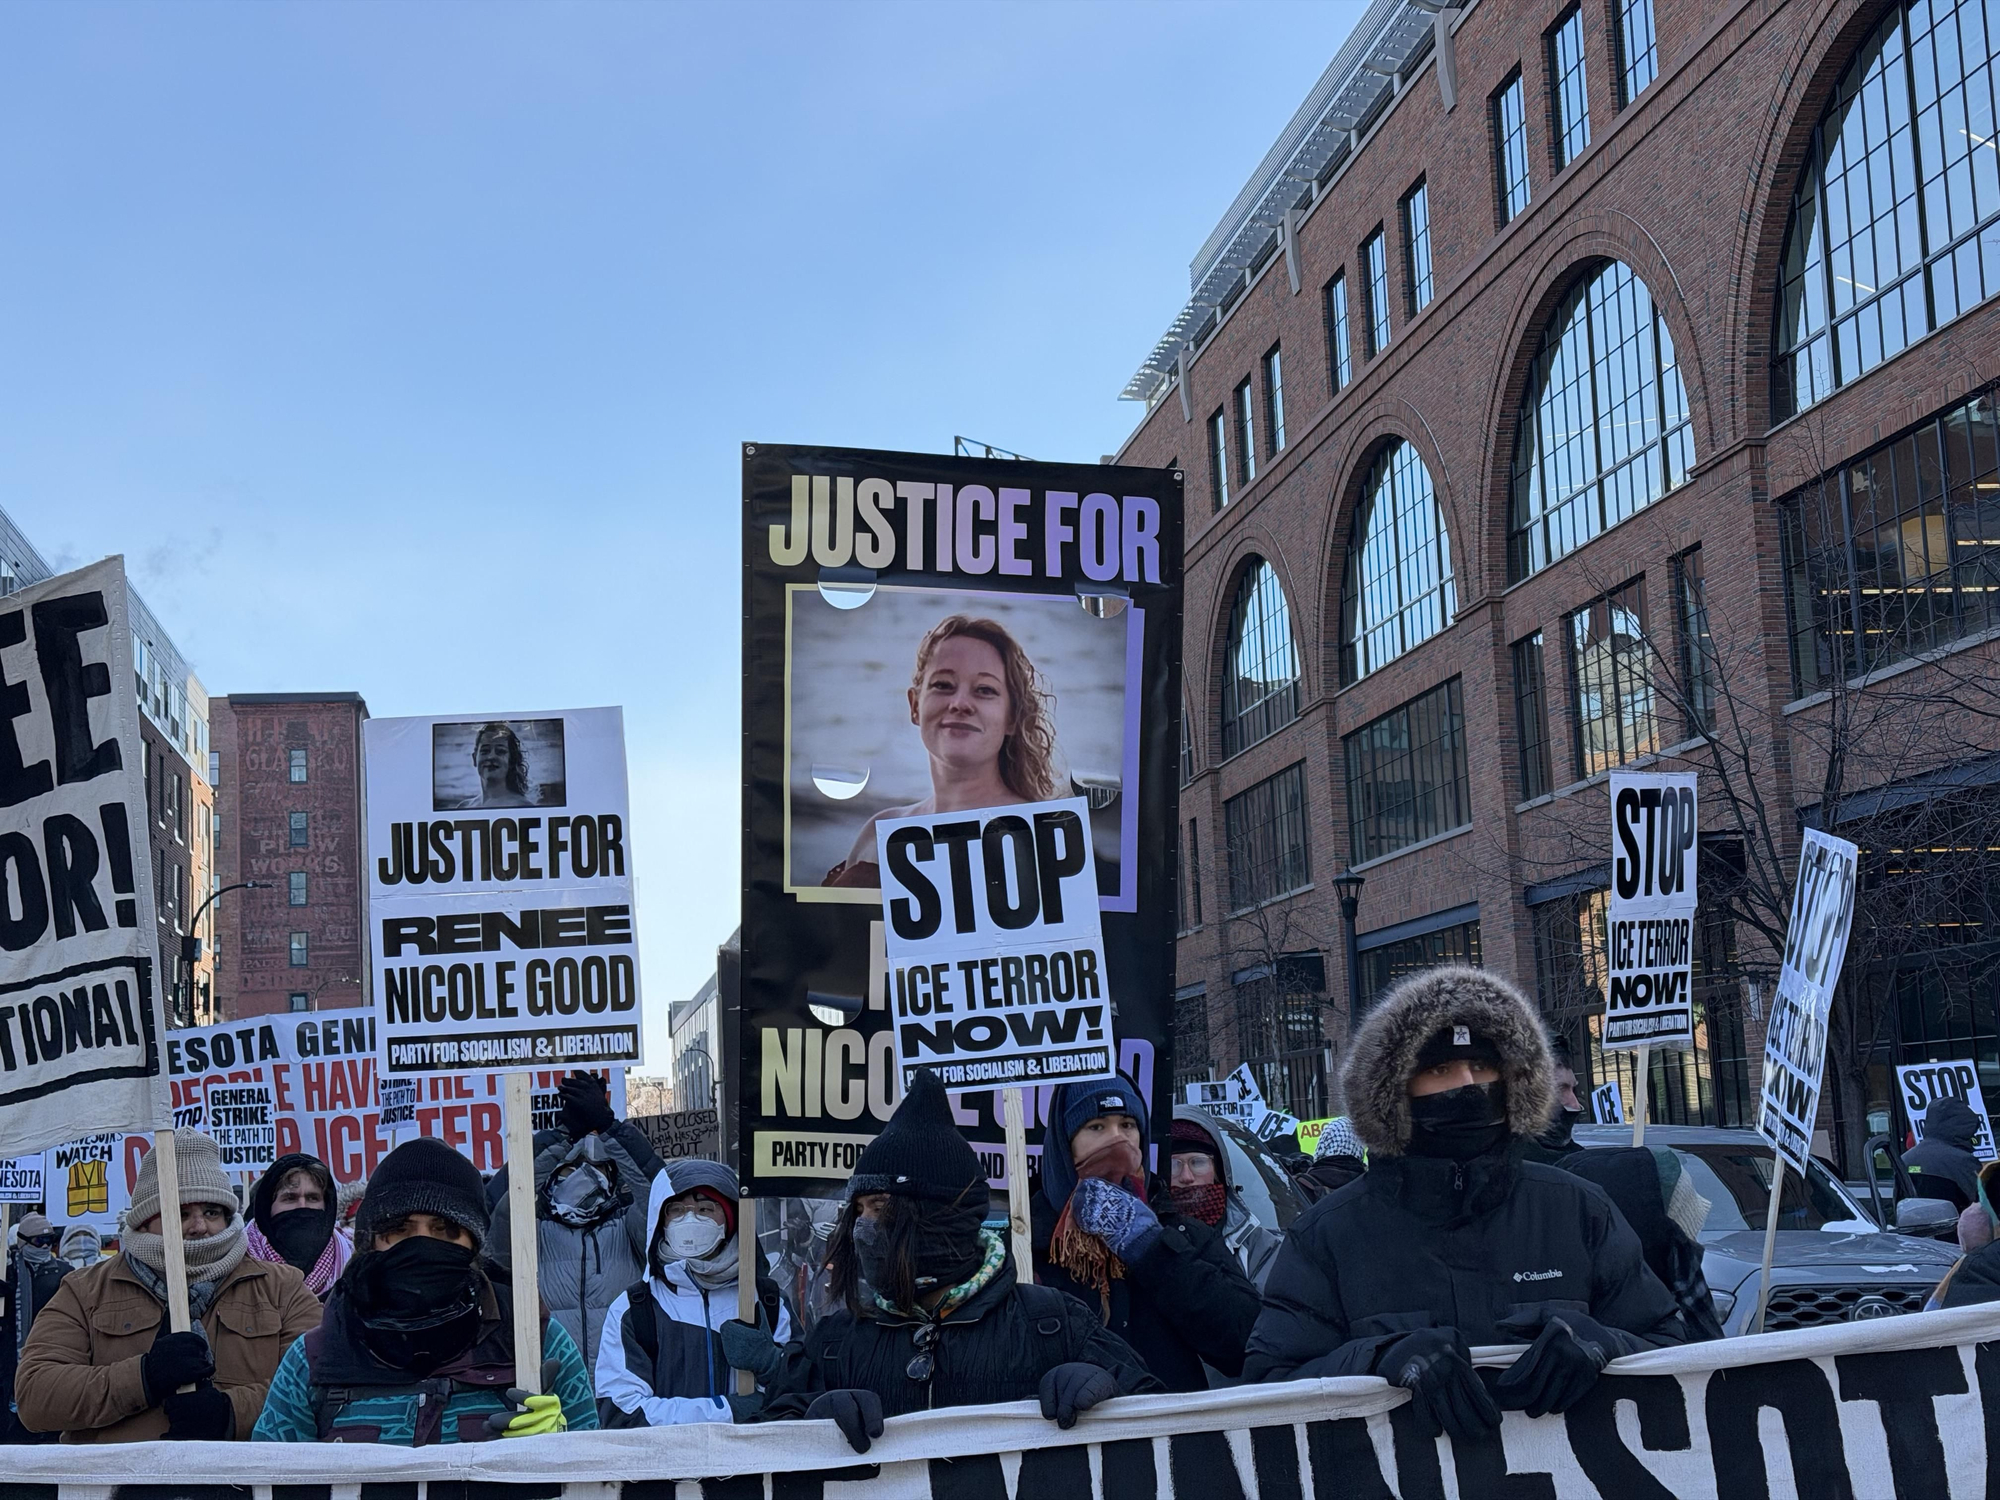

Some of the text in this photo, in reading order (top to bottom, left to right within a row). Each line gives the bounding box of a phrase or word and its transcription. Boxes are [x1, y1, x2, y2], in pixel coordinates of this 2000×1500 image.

[768, 474, 1161, 584] JUSTICE FOR
[378, 814, 625, 886] JUSTICE FOR
[1616, 786, 1694, 900] STOP
[0, 802, 138, 952] OR!
[885, 810, 1087, 941] STOP
[382, 904, 632, 957] RENEE
[1786, 841, 1855, 987] STOP
[1611, 918, 1689, 970] ICE TERROR
[384, 955, 635, 1025] NICOLE GOOD
[895, 963, 954, 1017] ICE
[957, 948, 1100, 1011] TERROR
[1609, 971, 1689, 1010] NOW!
[900, 1005, 1104, 1059] NOW!
[1767, 991, 1787, 1053] ICE
[168, 1025, 280, 1074] ESOTA
[391, 1031, 633, 1064] PARTY FOR SOCIALISM & LIBERATION
[942, 1065, 966, 1084] FOR
[966, 1059, 1025, 1081] SOCIALISM
[1027, 1058, 1041, 1075] &
[1043, 1052, 1106, 1073] LIBERATION
[211, 1088, 271, 1107] GENERAL
[381, 1088, 416, 1107] THE PATH TO
[1597, 1084, 1620, 1124] ICE
[1903, 1065, 1975, 1111] STOP
[172, 1106, 203, 1130] TOP
[212, 1106, 273, 1127] STRIKE:
[381, 1105, 415, 1125] JUSTICE
[657, 1116, 671, 1132] IS
[674, 1110, 718, 1129] CLOSED
[1224, 1102, 1238, 1115] FOR
[1256, 1112, 1290, 1139] ICE
[213, 1127, 275, 1145] THE PATH TO
[56, 1145, 113, 1169] WATCH
[772, 1140, 829, 1168] PARTY
[974, 1152, 1004, 1179] ND
[1522, 1269, 1563, 1281] Columbia
